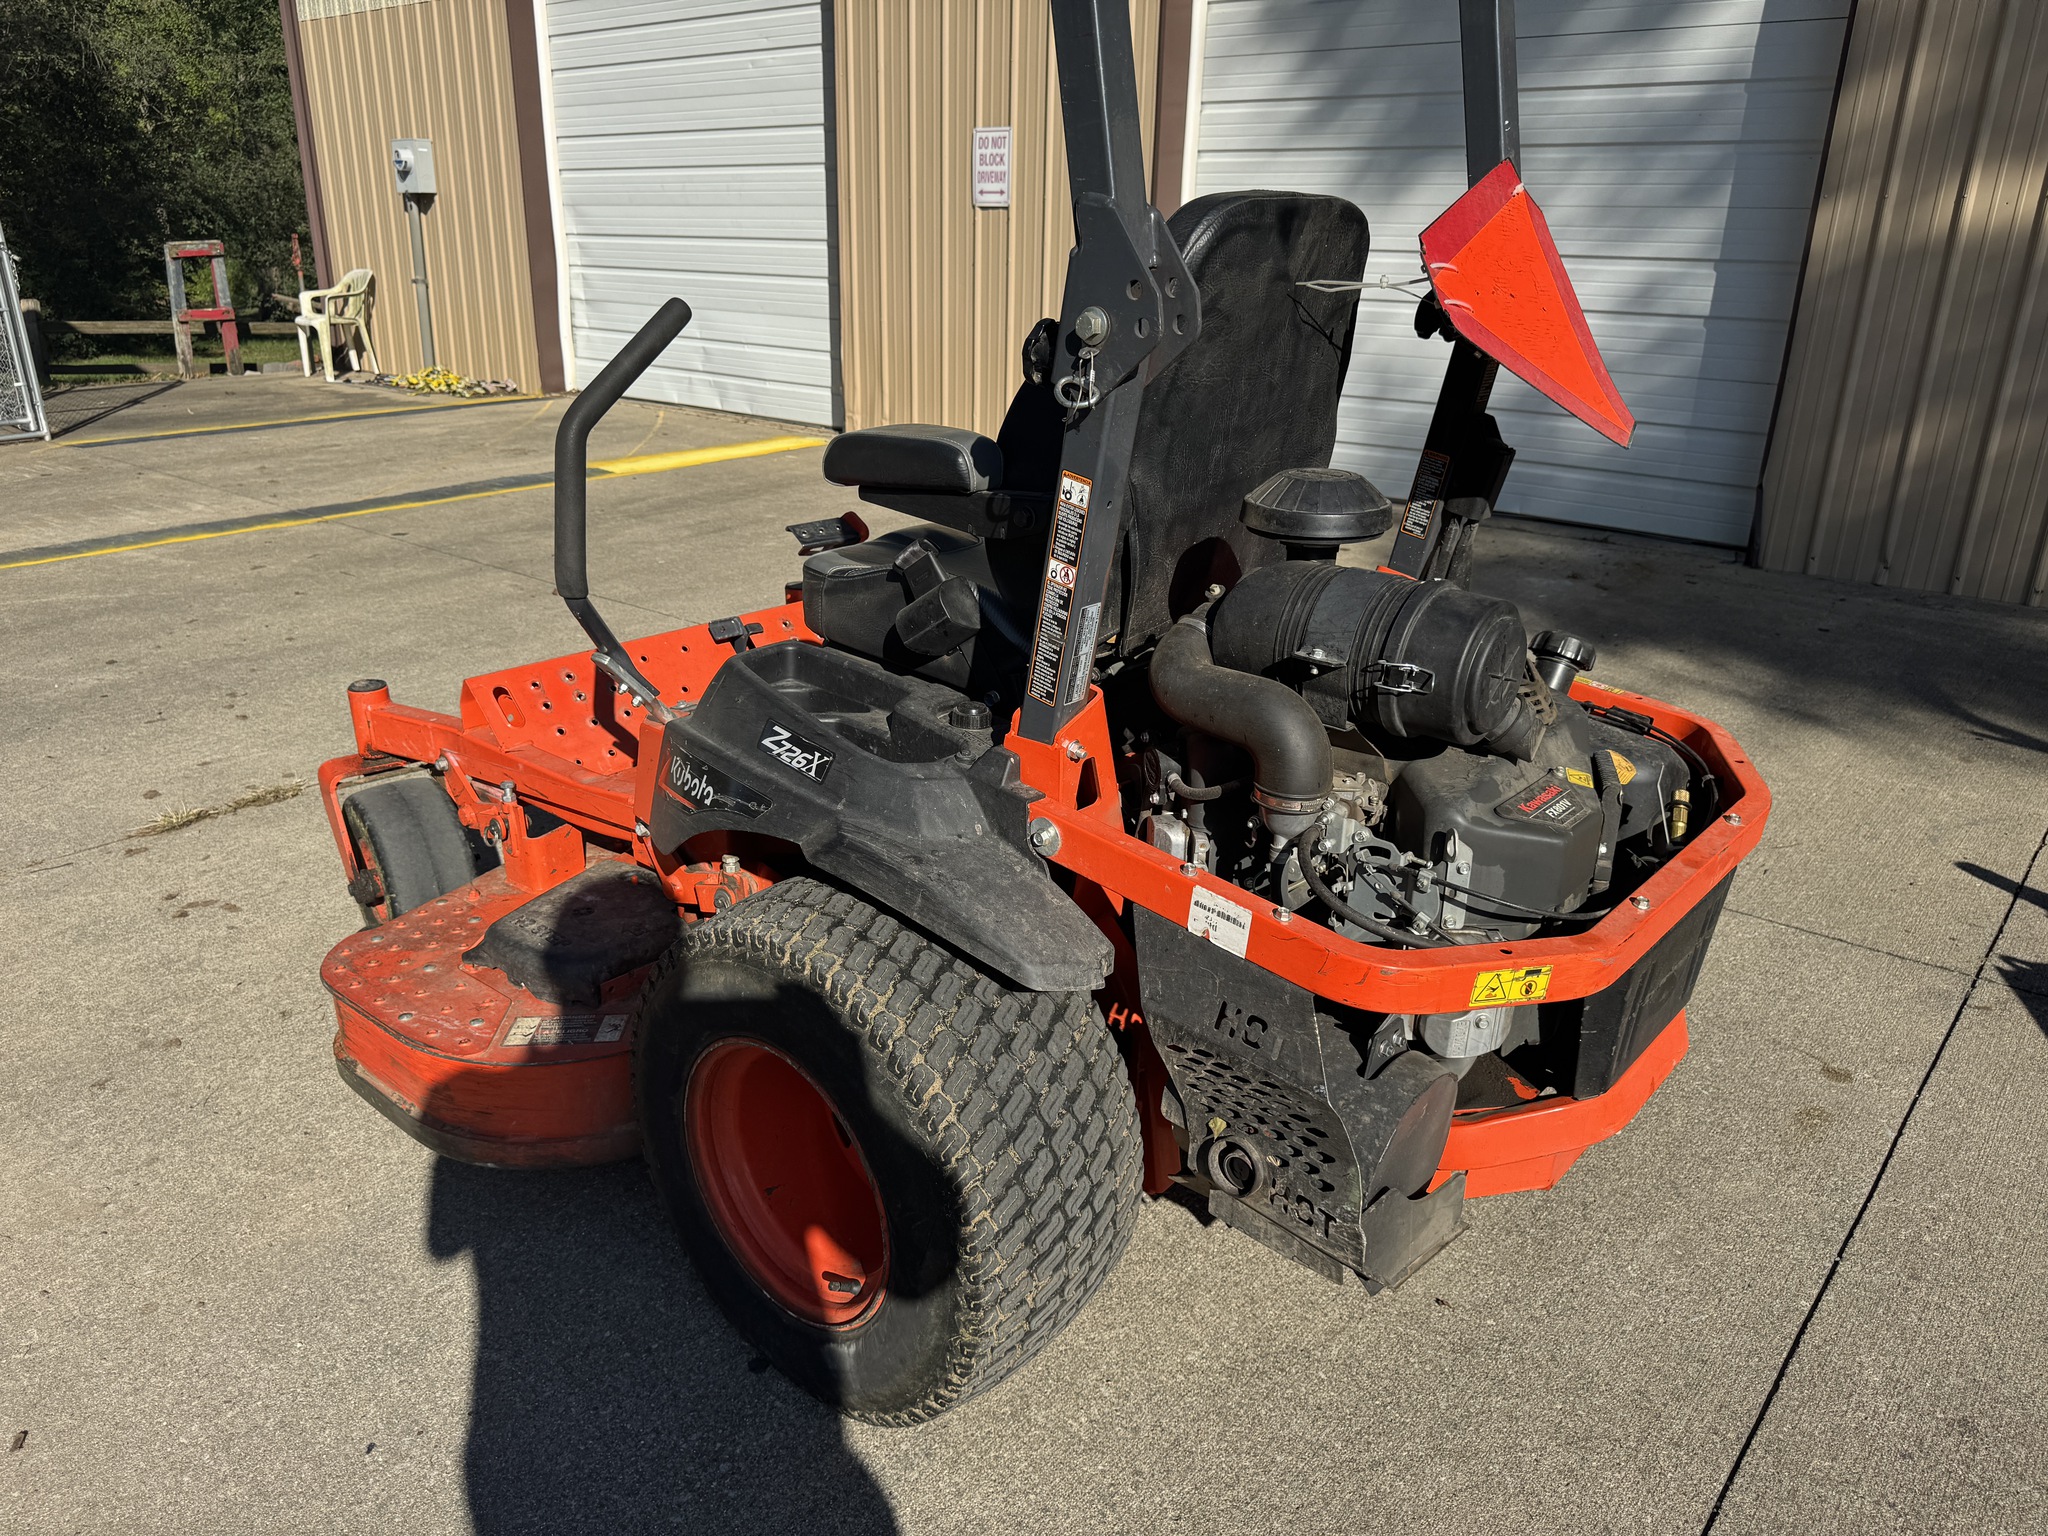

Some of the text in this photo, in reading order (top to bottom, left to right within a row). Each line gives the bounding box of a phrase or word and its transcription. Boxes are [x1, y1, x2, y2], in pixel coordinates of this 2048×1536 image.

[978, 136, 1007, 150] DO NOT
[979, 153, 1005, 166] BLOCK
[977, 170, 1006, 184] DRIVEWAY
[761, 725, 830, 777] Z726X
[670, 755, 714, 806] Kubota
[1518, 784, 1563, 813] Kawasaki
[1545, 798, 1572, 819] FX801V
[1269, 1176, 1337, 1240] HOT
